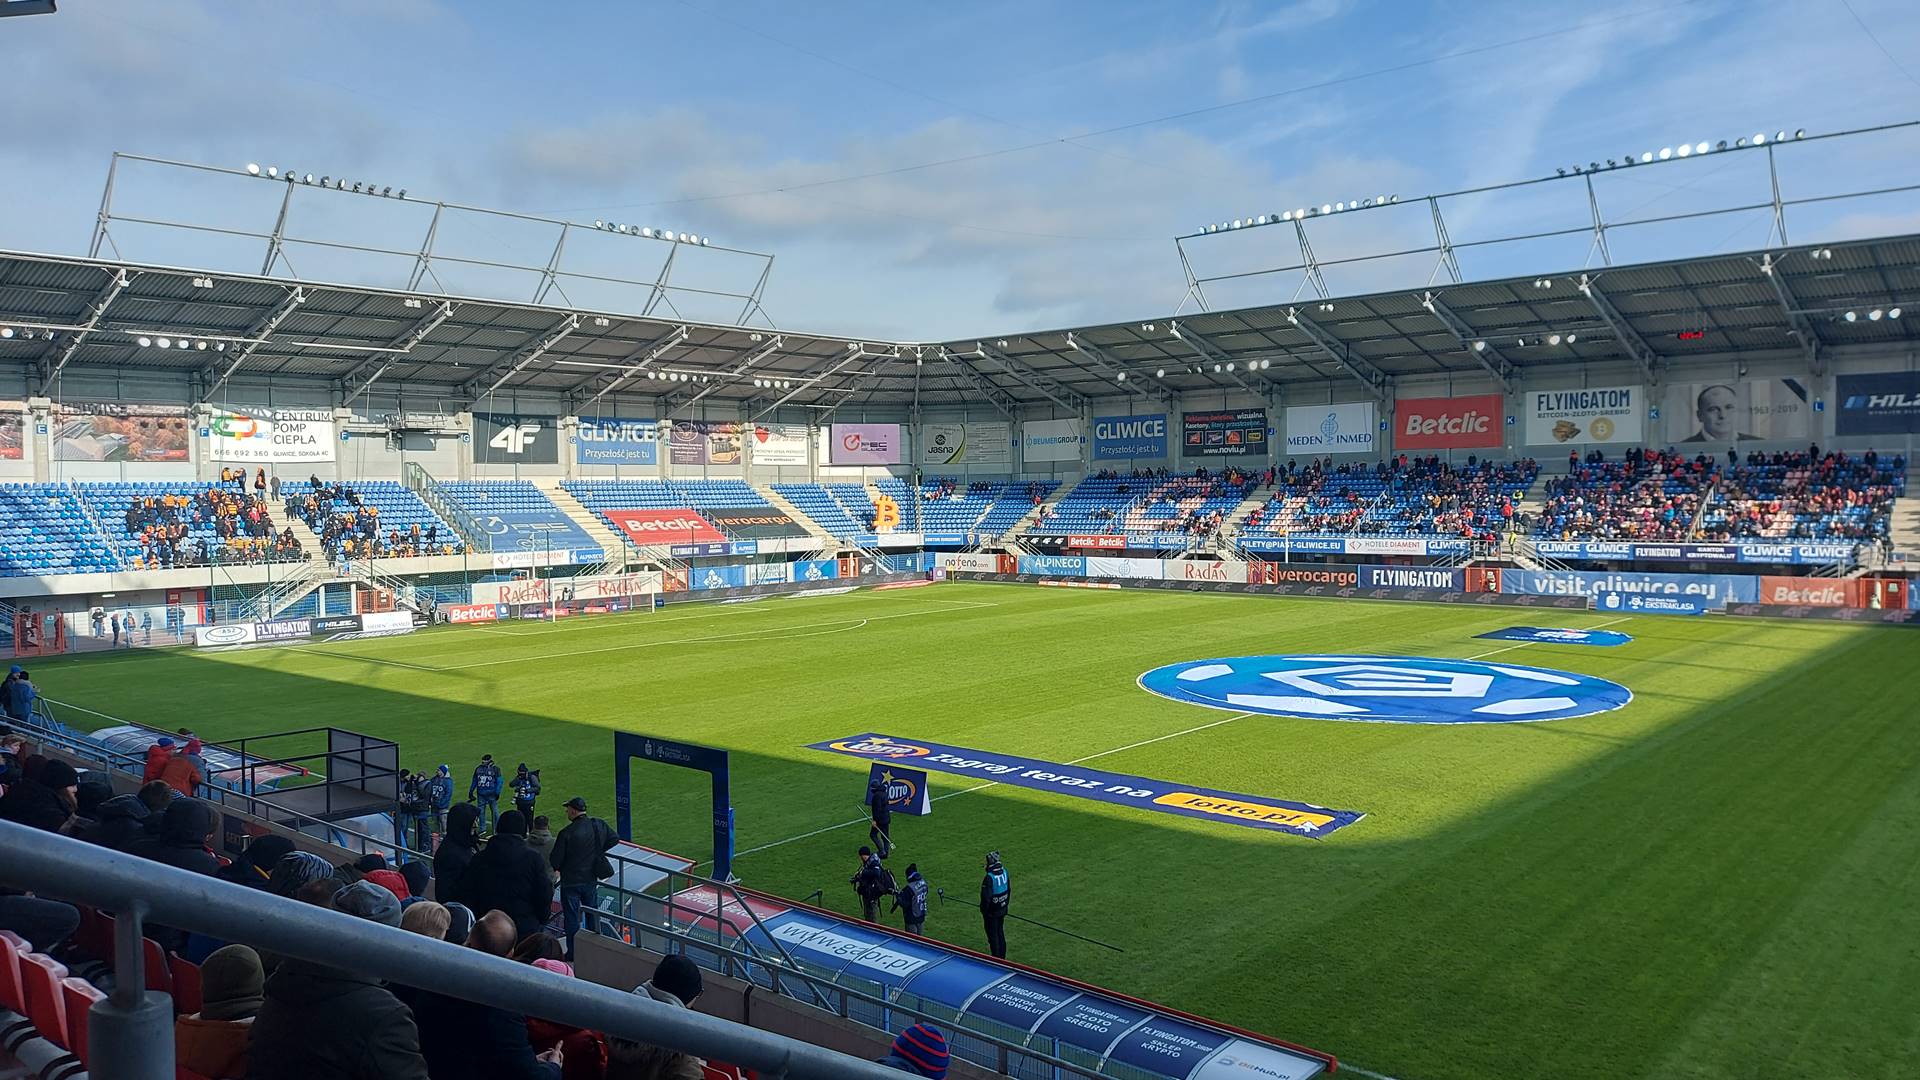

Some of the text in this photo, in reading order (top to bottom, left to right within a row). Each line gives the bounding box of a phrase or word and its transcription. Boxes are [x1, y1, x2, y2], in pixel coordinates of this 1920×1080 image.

[1538, 390, 1630, 410] FLYINGATOM
[274, 412, 330, 421] CENTRUM
[1508, 416, 1514, 424] K
[274, 423, 306, 432] POMP
[1406, 410, 1490, 435] Betclic
[580, 421, 656, 442] GLIWICE
[1096, 420, 1164, 440] GLIWICE
[490, 424, 541, 453] 4F
[1288, 434, 1372, 446] MEDEN INMED
[585, 449, 625, 458] Przyszłość
[625, 450, 640, 458] jest
[1101, 446, 1136, 455] Przyszłość
[1136, 446, 1149, 455] jest
[625, 518, 704, 532] Betclic
[716, 516, 792, 526] verocargo
[1071, 537, 1095, 546] Betclic
[1099, 538, 1124, 547] Betclic
[1128, 536, 1154, 544] GLIWICE
[1428, 541, 1466, 549] GLIWICE
[1538, 544, 1580, 552] GLIWICE
[1586, 544, 1630, 553] GLIWICE
[1635, 548, 1680, 557] FLYINGATOM
[1742, 546, 1792, 556] GLIWICE
[1035, 558, 1081, 568] ALPINECO
[861, 564, 873, 574] 4F
[1279, 571, 1357, 586] verocargo
[1373, 569, 1452, 587] FLYINGATOM
[1273, 584, 1292, 594] 4F
[1304, 586, 1327, 594] 4F
[1336, 587, 1360, 598] 4F
[1369, 589, 1390, 599] 4F
[1404, 590, 1426, 600] 4F
[1440, 592, 1461, 602] 4F
[1474, 593, 1500, 603] 4F
[1511, 594, 1538, 605] 4F
[1774, 585, 1845, 605] Betclic
[1553, 596, 1581, 608] 4F
[1645, 602, 1694, 610] EKSTRAKLASA
[451, 605, 495, 621] Betclic
[1734, 605, 1762, 615] 4F
[1783, 607, 1812, 617] 4F
[1834, 609, 1862, 620] 4F
[1884, 610, 1914, 622] 4F
[256, 621, 310, 635] FLYINGATOM
[884, 784, 907, 799] OTTO
[1021, 767, 1104, 789] teraz
[1104, 785, 1153, 798] na
[1184, 797, 1303, 822] lotto.pl
[782, 926, 920, 970] www.gapr.pl
[982, 993, 1044, 1015] KRYPTOWALUT
[1001, 993, 1036, 1007] KANTOR
[1064, 1016, 1109, 1033] SREBRO
[1141, 1042, 1181, 1058] KRYPTO
[1150, 1039, 1181, 1051] SKLEP
